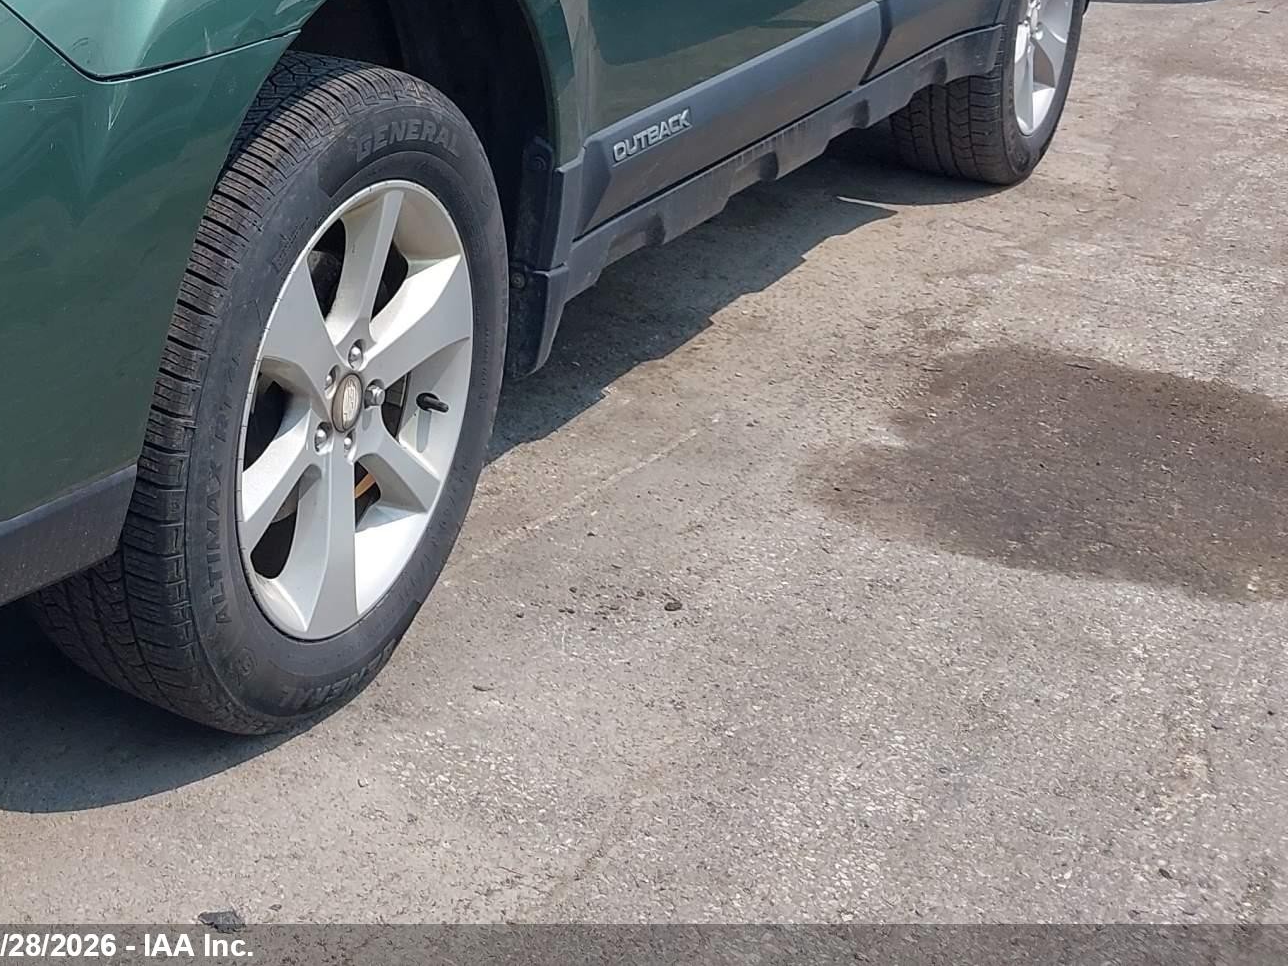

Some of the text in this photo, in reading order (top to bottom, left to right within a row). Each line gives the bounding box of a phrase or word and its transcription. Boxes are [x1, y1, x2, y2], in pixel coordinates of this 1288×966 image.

[356, 118, 461, 163] GENERAL
[613, 108, 692, 162] OUTBACK
[205, 459, 232, 625] ALTIMAX
